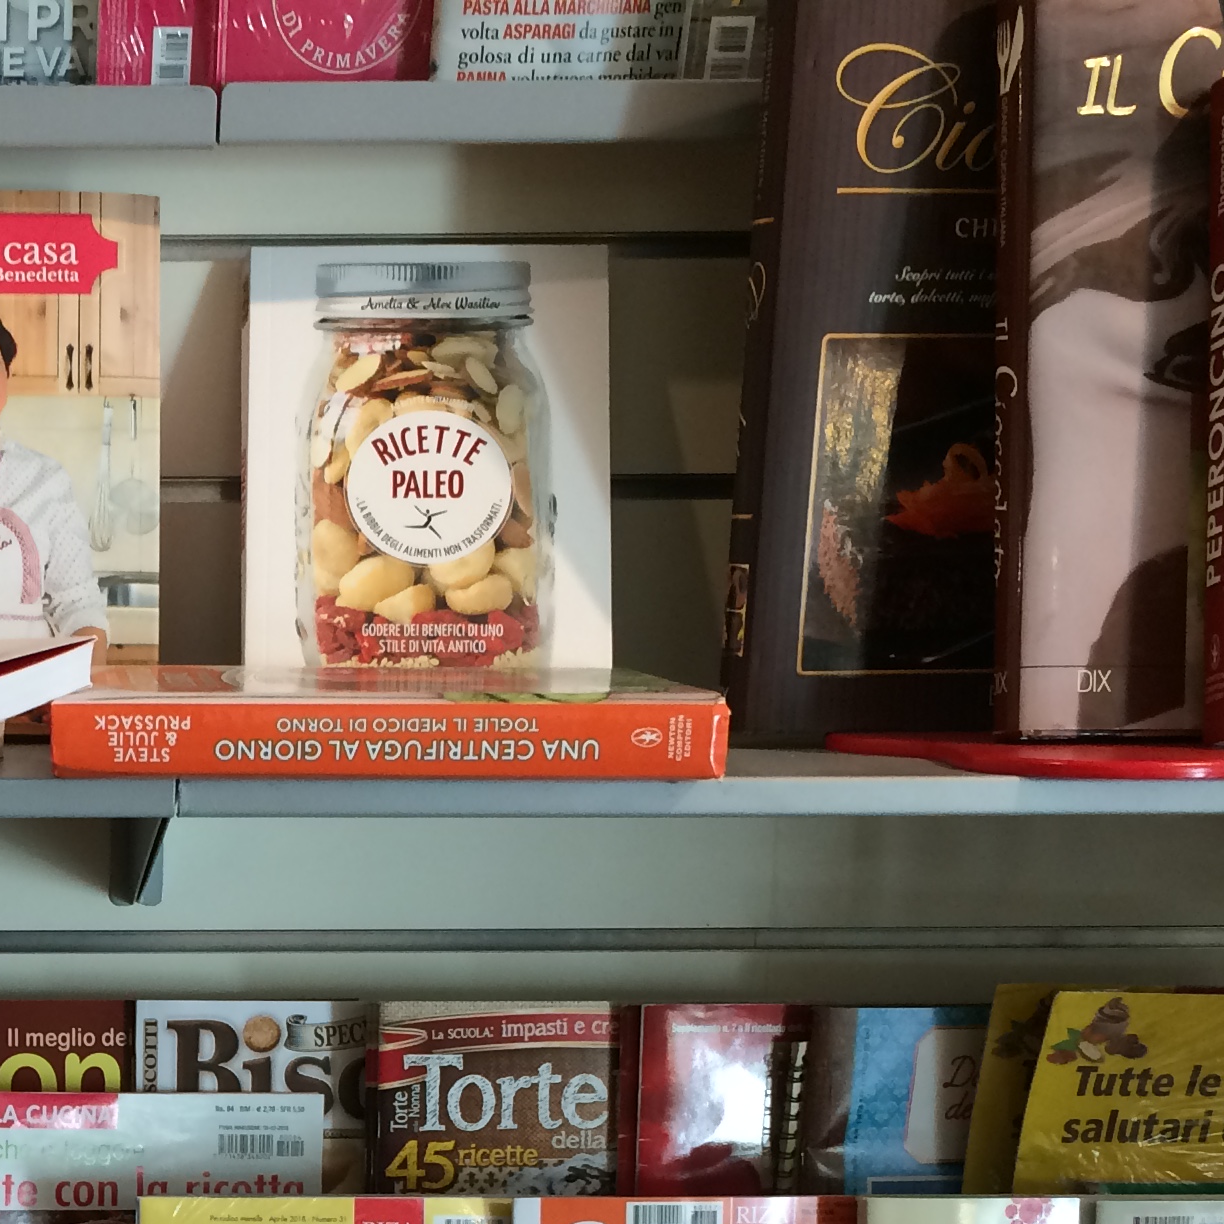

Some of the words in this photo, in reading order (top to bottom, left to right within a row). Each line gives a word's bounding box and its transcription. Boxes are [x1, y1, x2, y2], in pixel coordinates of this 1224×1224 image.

[281, 10, 301, 28] DI
[300, 10, 412, 69] PRIMAVERA
[461, 21, 500, 40] volta
[503, 23, 576, 40] ASPARAGI
[579, 21, 597, 40] da
[601, 22, 656, 45] gustare
[659, 20, 674, 38] in
[3, 240, 78, 266] casa
[371, 424, 488, 467] RICETTE
[391, 470, 465, 499] PALEO
[362, 623, 401, 637] GODERE
[404, 623, 419, 637] DEI
[422, 623, 465, 637] BENEFICI
[468, 623, 477, 637] DI
[480, 624, 504, 637] UNO
[1077, 668, 1112, 695] DIX
[277, 718, 343, 733] TORNO
[350, 718, 367, 733] DI
[373, 718, 447, 733] MEDICO
[453, 718, 466, 733] IL
[474, 718, 539, 733] TOGLIE
[215, 739, 322, 761] GIORNO
[329, 739, 360, 761] AL
[366, 739, 534, 761] CENTRIFUGA
[543, 739, 600, 761] UNA
